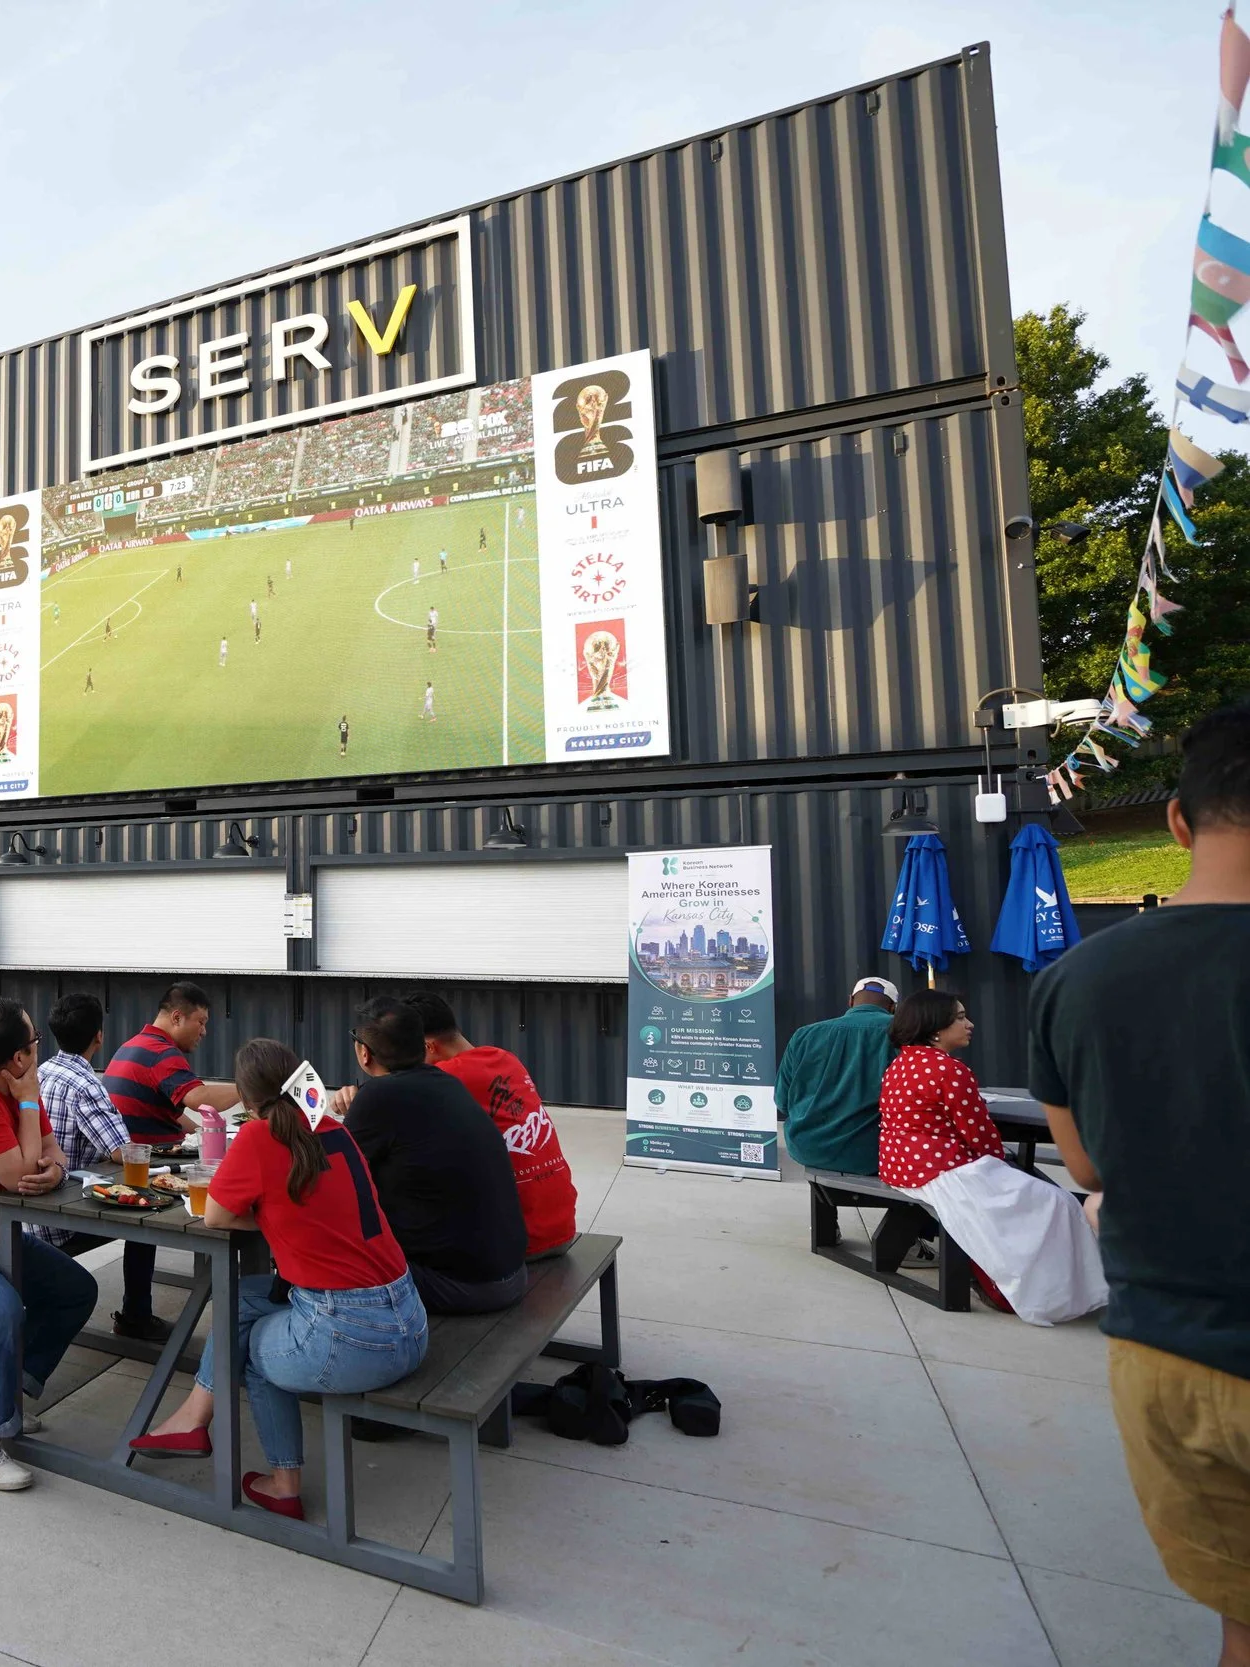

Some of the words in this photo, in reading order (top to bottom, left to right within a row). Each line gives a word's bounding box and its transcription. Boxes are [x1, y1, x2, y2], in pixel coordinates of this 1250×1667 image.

[128, 283, 417, 415] SERV
[479, 410, 508, 430] FOX
[430, 440, 447, 449] LIVE
[453, 426, 514, 444] GUADALAJARA
[576, 457, 614, 475] FIFA
[170, 481, 186, 492] 7:23
[96, 498, 101, 507] 0
[117, 494, 121, 503] 0
[566, 497, 624, 515] ULTRA
[354, 504, 387, 518] QATAR
[391, 499, 433, 512] AIRWAYS
[99, 542, 122, 552] QATAR
[124, 538, 154, 549] AIRWAYS
[55, 558, 70, 572] QATAR
[571, 552, 624, 578] STELLA
[571, 578, 626, 604] ARTOIS
[556, 724, 600, 733] PROUDLY
[605, 721, 644, 729] HOSTED
[571, 738, 615, 748] KANSAS
[619, 736, 645, 744] CITY
[661, 882, 695, 890] Where
[699, 880, 738, 889] Korean
[641, 890, 692, 899] American
[695, 888, 760, 897] Businesses
[679, 899, 709, 908] Grow
[714, 898, 724, 907] in
[663, 909, 703, 922] Kansas
[709, 908, 734, 925] City
[503, 1104, 553, 1156] REDS
[545, 1156, 563, 1167] KOREA
